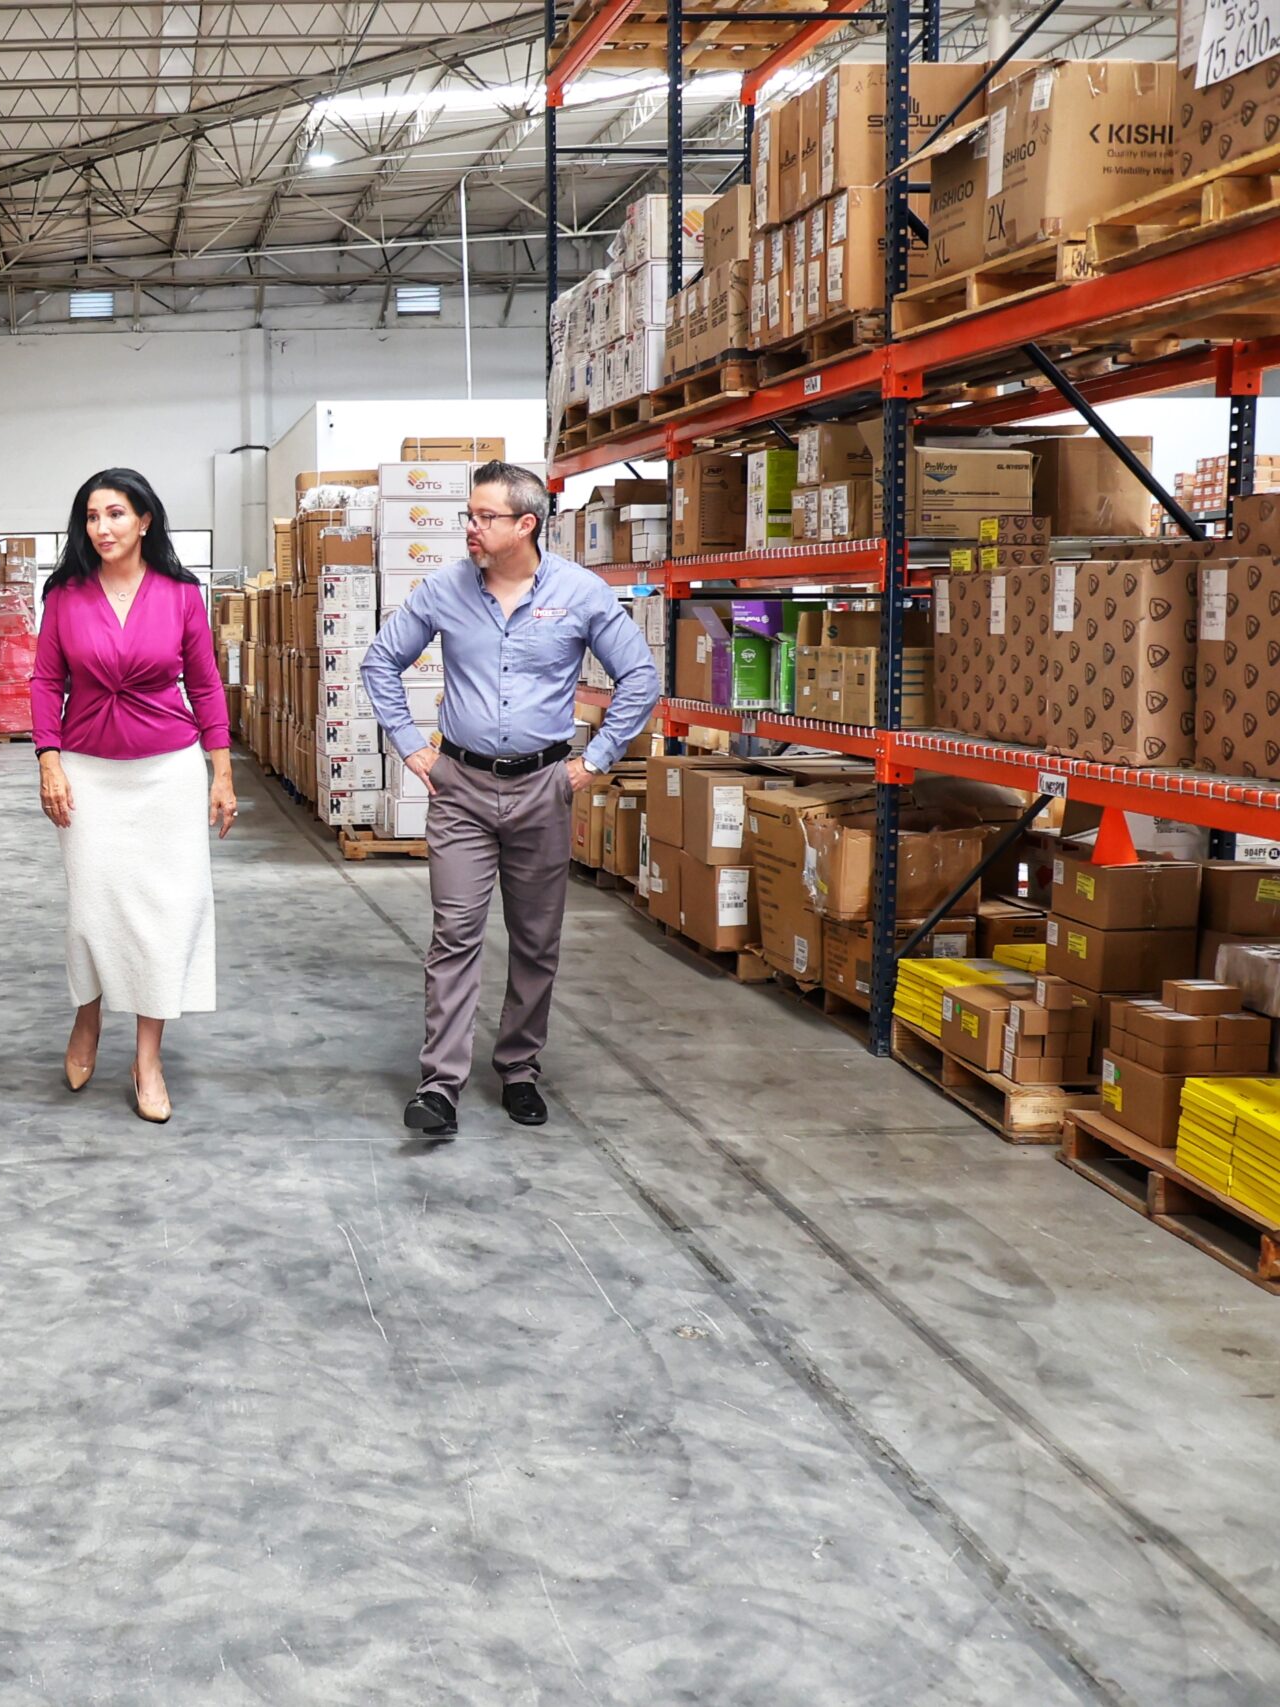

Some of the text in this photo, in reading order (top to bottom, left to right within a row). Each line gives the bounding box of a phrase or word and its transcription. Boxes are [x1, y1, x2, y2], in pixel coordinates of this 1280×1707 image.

[1108, 123, 1173, 144] KISHI
[1003, 140, 1036, 169] SHIGO
[924, 462, 958, 471] ProWorks
